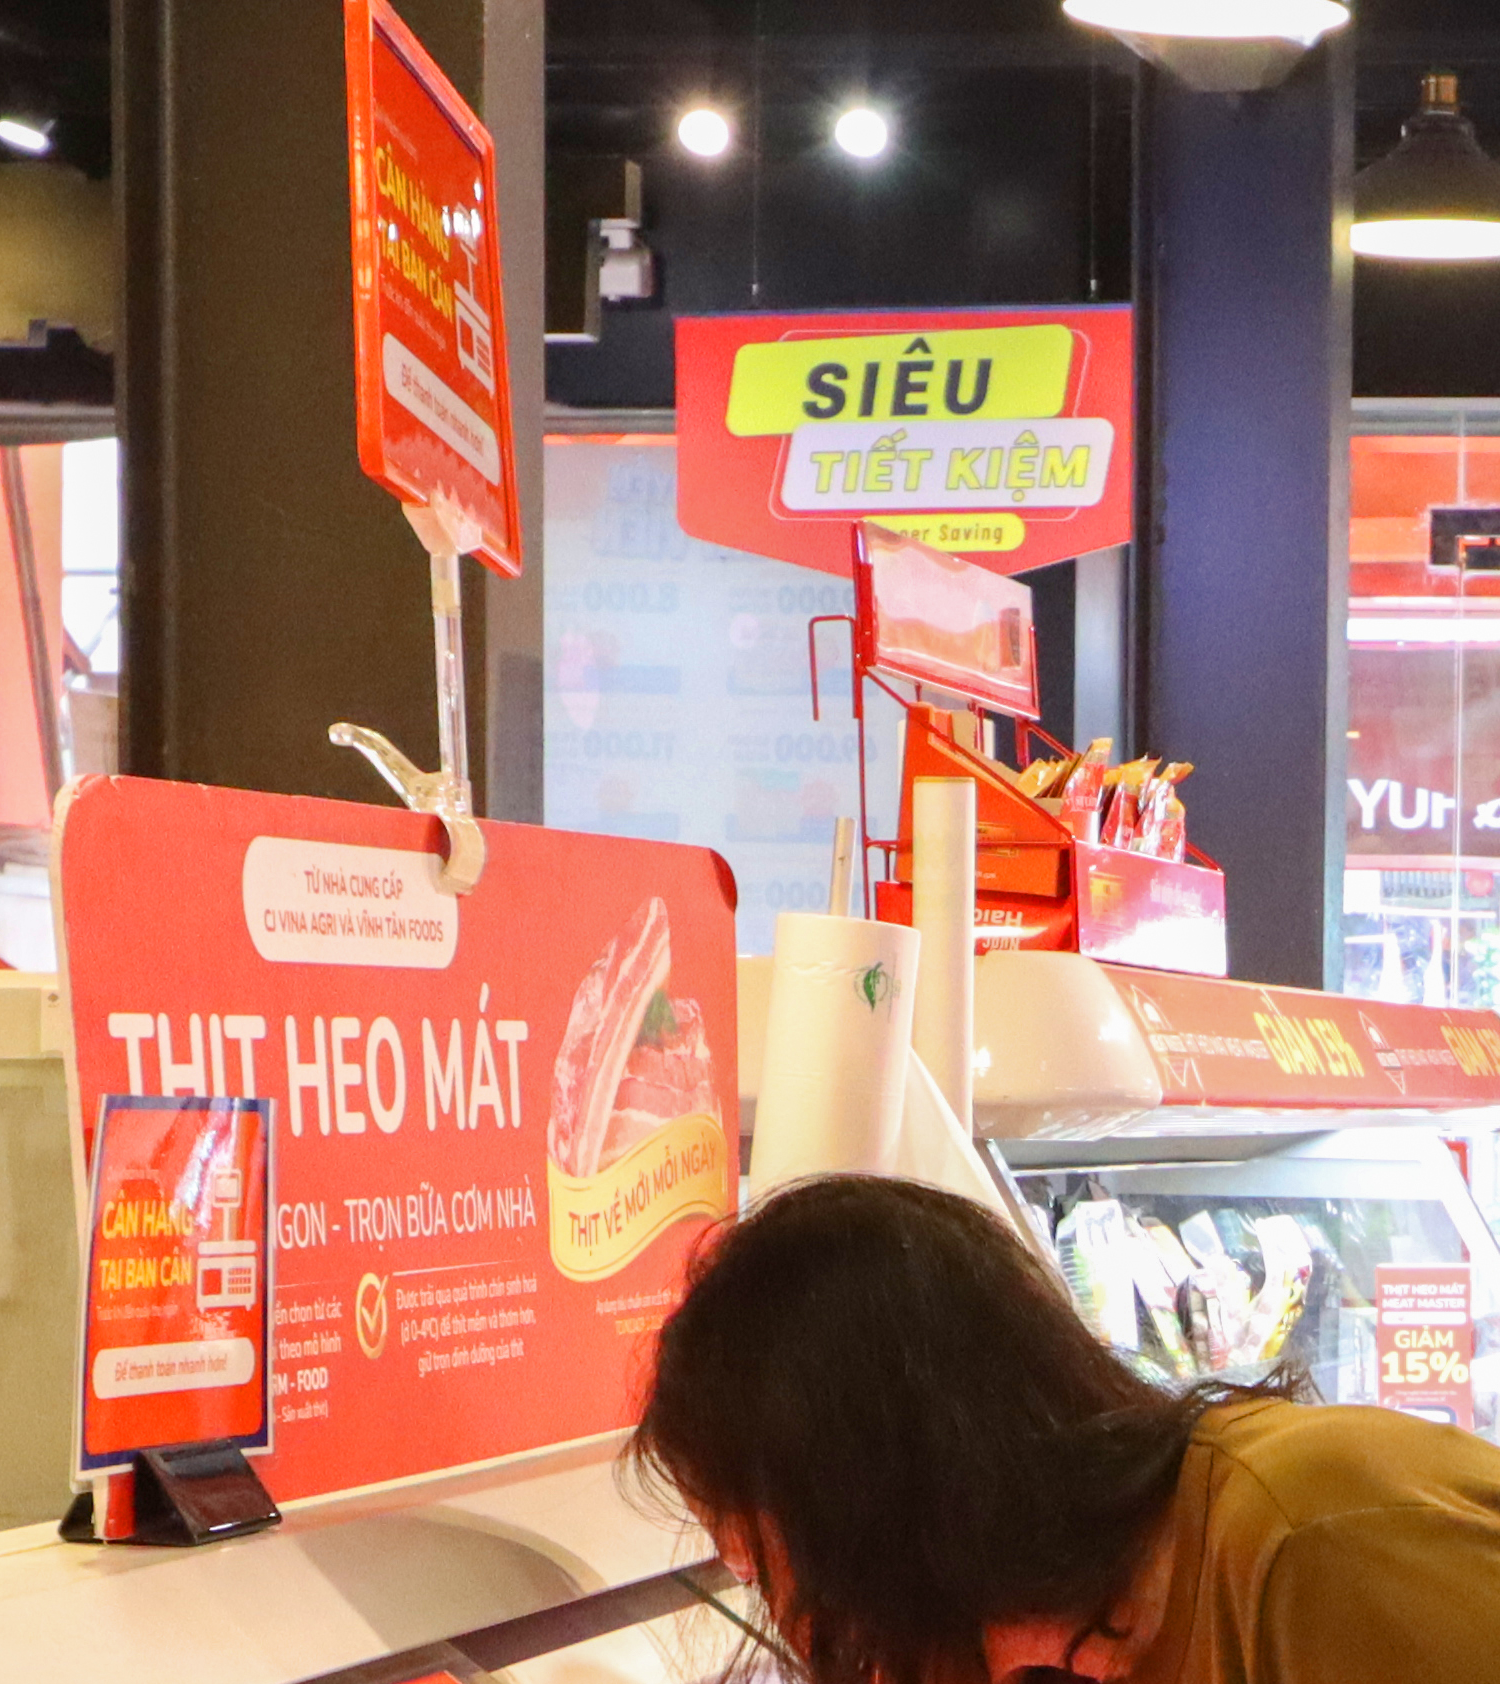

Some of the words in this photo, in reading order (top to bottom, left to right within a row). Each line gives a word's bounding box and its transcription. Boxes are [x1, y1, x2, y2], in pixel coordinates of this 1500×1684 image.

[802, 337, 992, 419] SIÊU
[809, 427, 934, 494] TIẾT
[945, 429, 1091, 503] KIỆM
[939, 522, 1004, 544] Saving
[304, 865, 321, 894] TỪ
[322, 866, 348, 896] NHÀ
[349, 875, 381, 898] CUNG
[382, 869, 404, 900] CẤP
[278, 911, 308, 934] VINA
[310, 911, 338, 936] AGRI
[339, 907, 355, 937] VÀ
[358, 909, 384, 939] VĨNH
[385, 911, 407, 940] TÂN
[408, 919, 444, 943] FOODS
[284, 1014, 407, 1138] HEO
[421, 981, 529, 1132] MÁT
[101, 1192, 140, 1241] CÂN
[141, 1197, 194, 1240] HÀNG
[273, 1201, 328, 1250] GON
[343, 1194, 403, 1253] TRỌN
[405, 1180, 449, 1238] BỮA
[450, 1183, 493, 1235] CƠM
[496, 1173, 538, 1230] NHÀ
[568, 1210, 600, 1257] THỊT
[624, 1169, 651, 1225] MỚI
[99, 1257, 124, 1301] TẠI
[124, 1246, 157, 1289] BÀN
[159, 1254, 192, 1288] CÂN
[1393, 1324, 1454, 1349] GIẢM
[296, 1367, 329, 1392] FOOD
[1381, 1350, 1469, 1384] 15%
